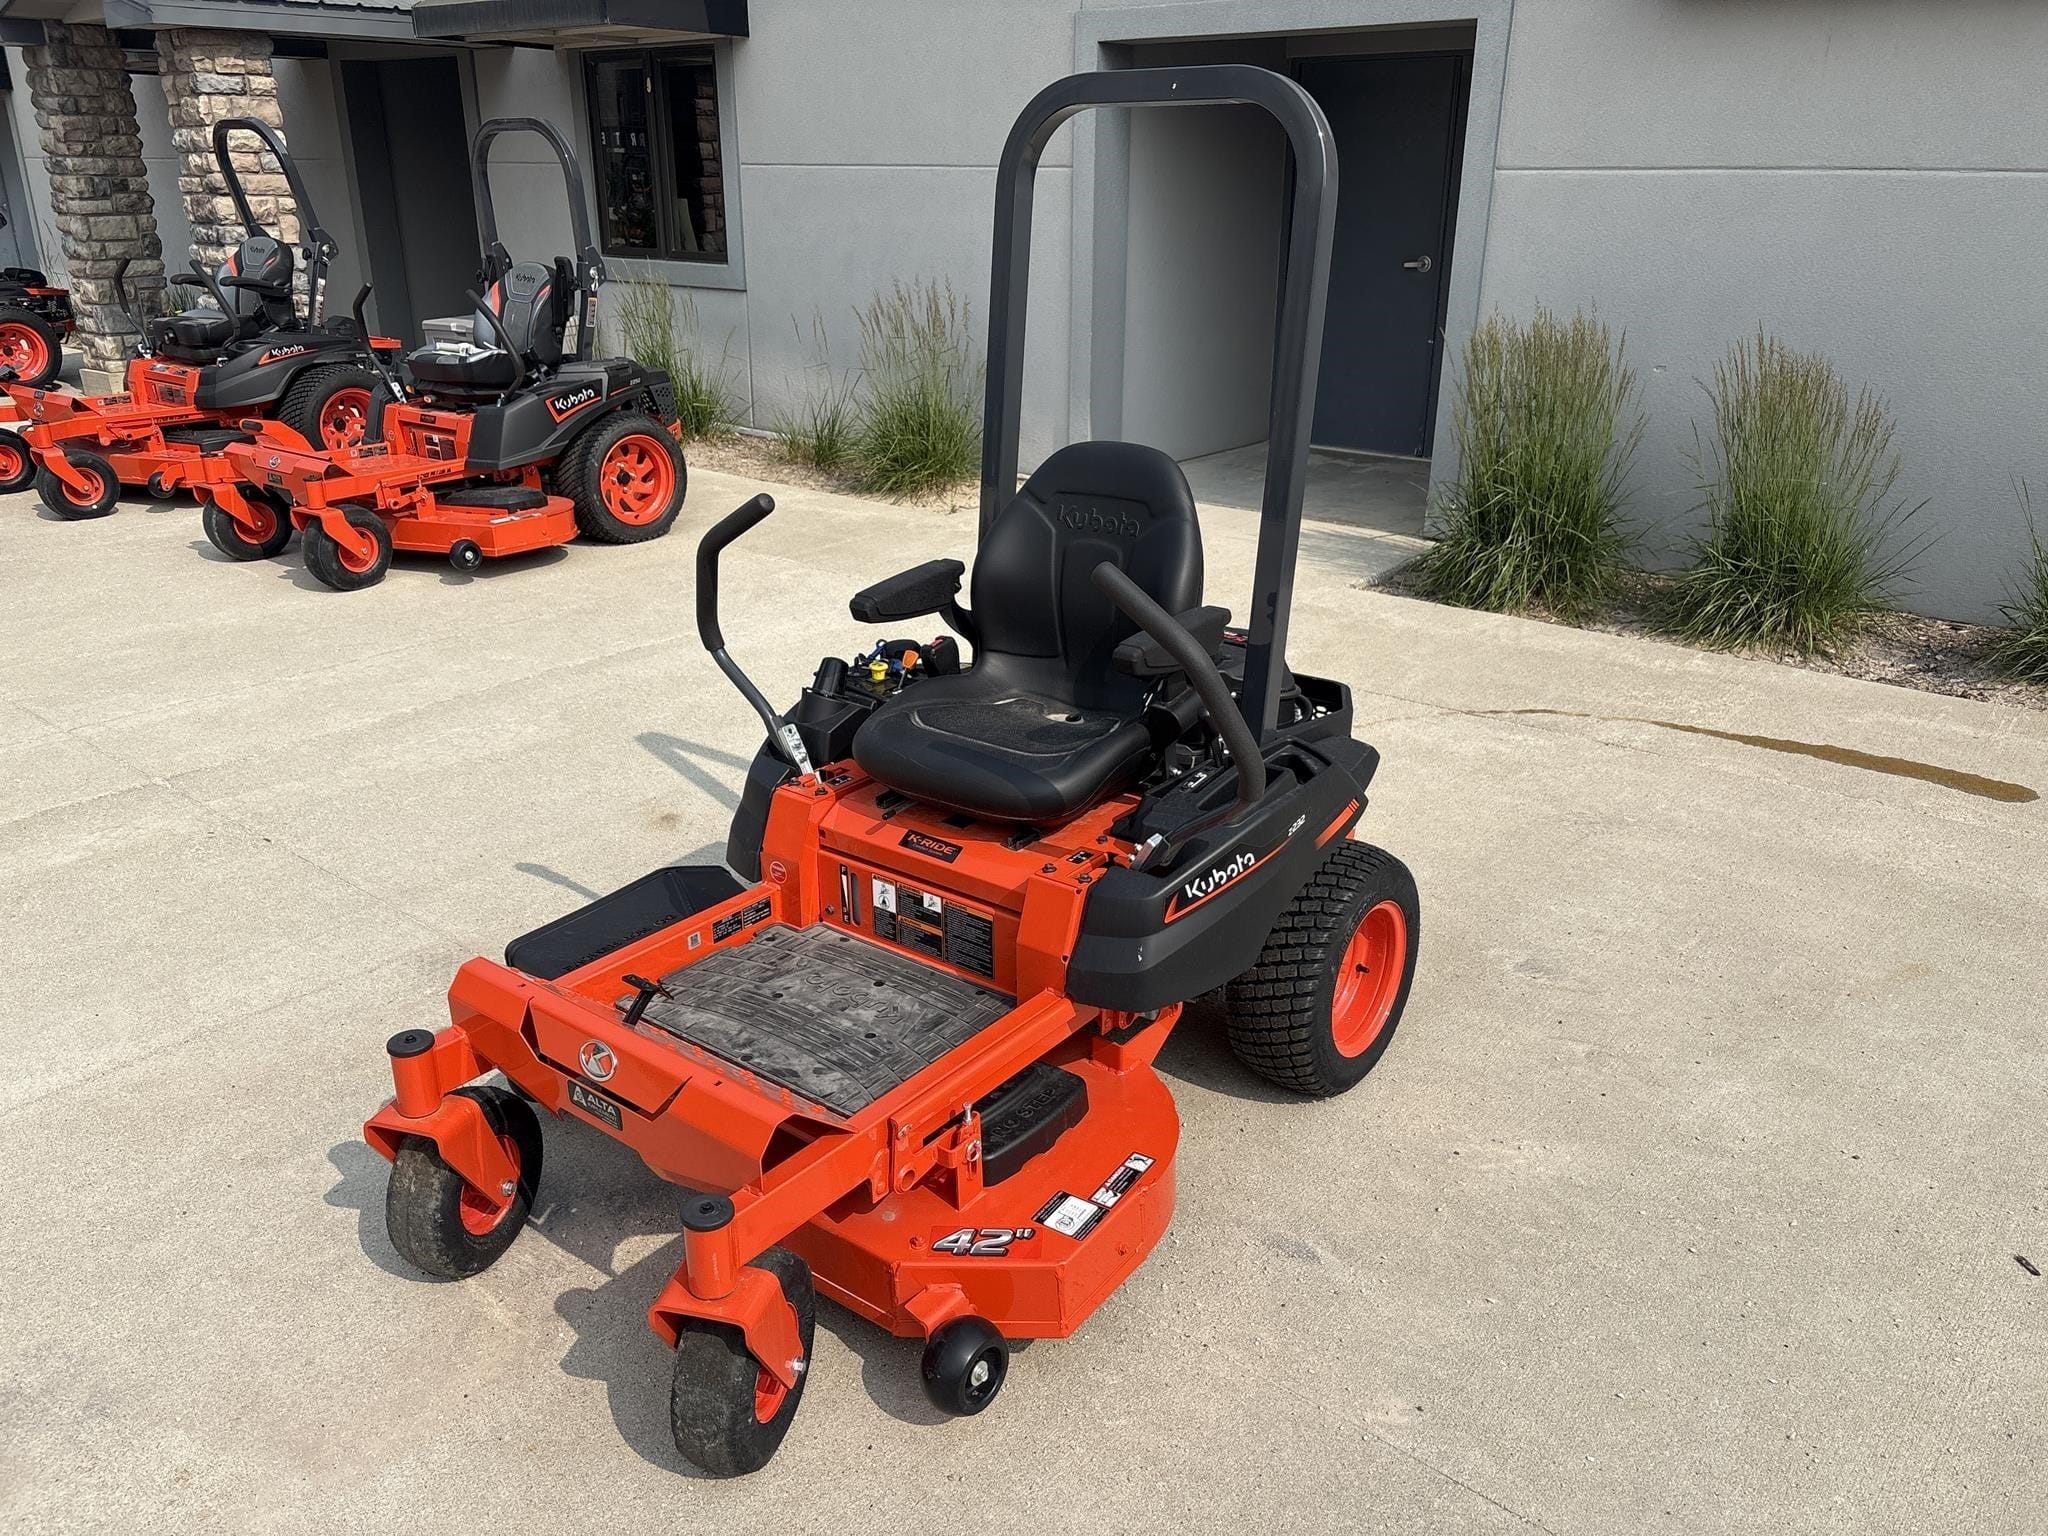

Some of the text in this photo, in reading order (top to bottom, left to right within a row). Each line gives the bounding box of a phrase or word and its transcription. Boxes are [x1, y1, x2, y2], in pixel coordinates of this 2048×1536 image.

[271, 345, 305, 357] Kubota
[554, 387, 595, 410] Kubota
[1057, 503, 1141, 537] Kubota
[1185, 852, 1256, 899] Kubota
[587, 1094, 617, 1117] ALTA
[932, 1228, 1036, 1257] 42"
